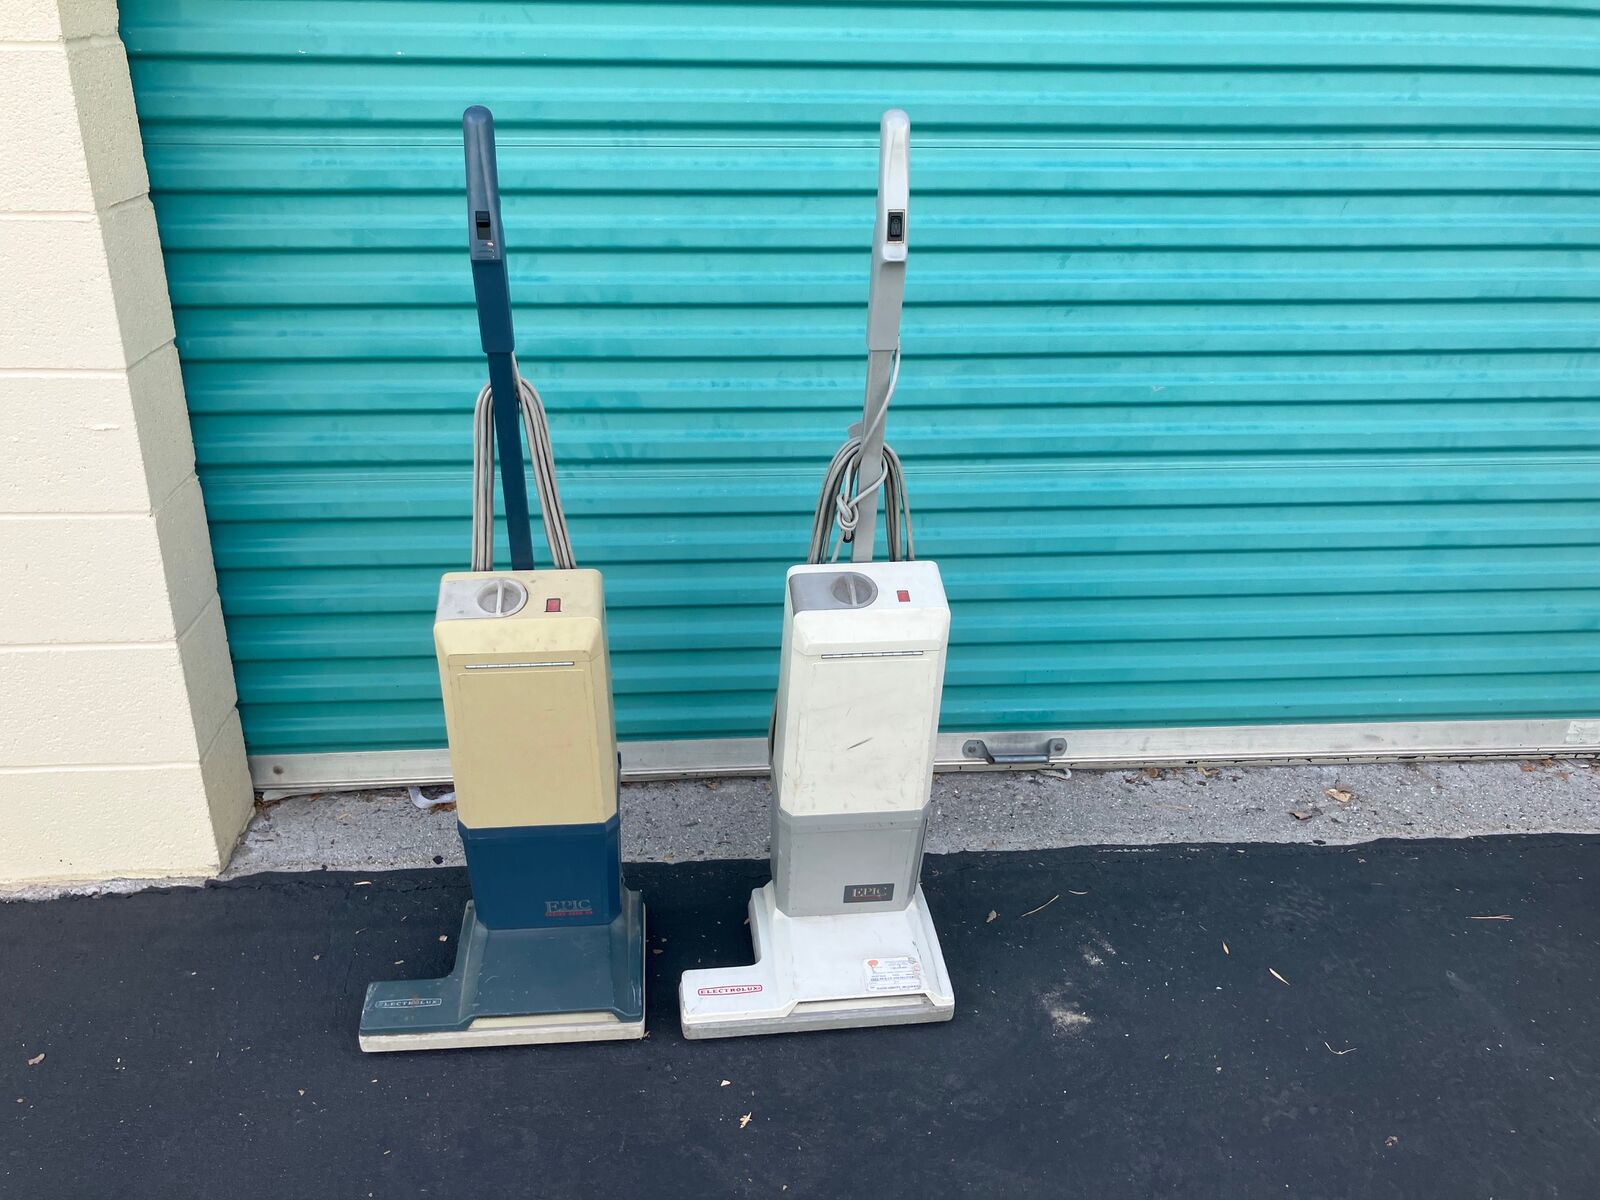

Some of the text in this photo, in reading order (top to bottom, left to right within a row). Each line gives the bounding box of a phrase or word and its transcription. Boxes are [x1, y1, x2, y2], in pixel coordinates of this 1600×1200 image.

[853, 887, 887, 897] EPIC
[545, 900, 592, 912] EPIC
[700, 987, 757, 995] ELECTROLUX
